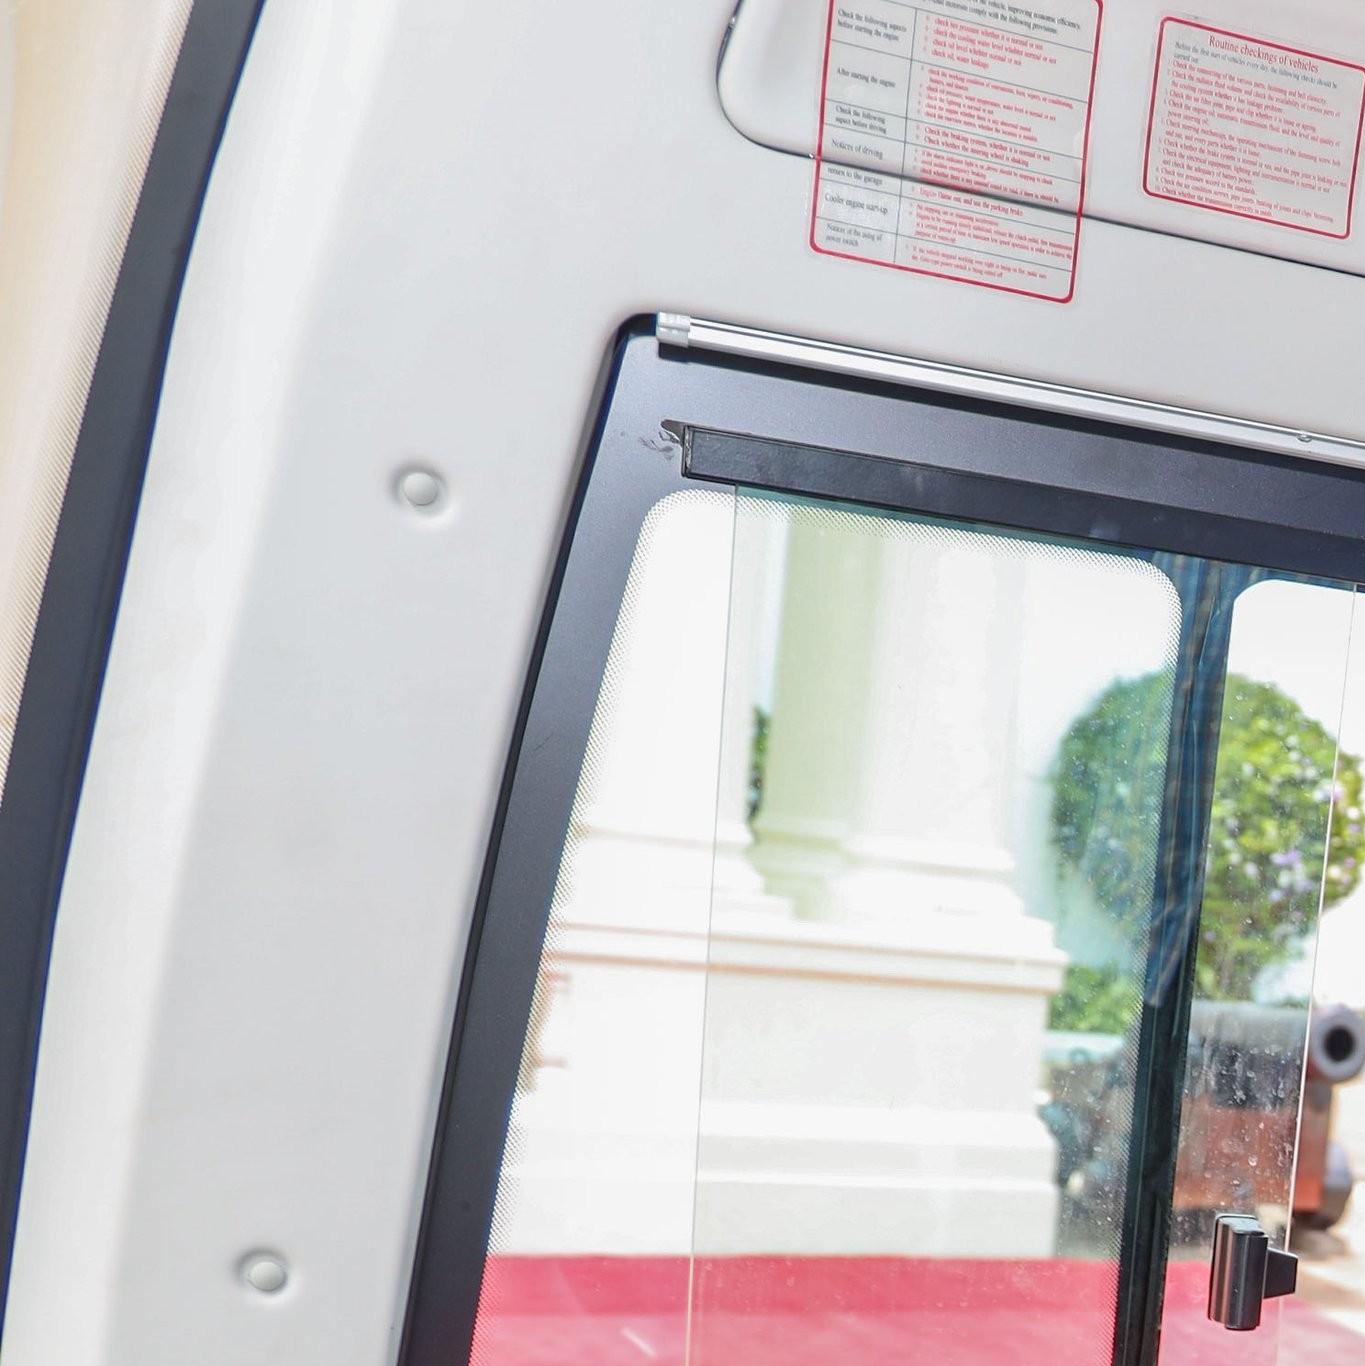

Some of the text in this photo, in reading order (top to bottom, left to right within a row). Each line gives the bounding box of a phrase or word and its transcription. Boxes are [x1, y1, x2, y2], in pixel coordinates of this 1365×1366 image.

[1208, 35, 1239, 53] Routine
[1240, 43, 1277, 65] checkings
[1288, 55, 1319, 73] vehicles
